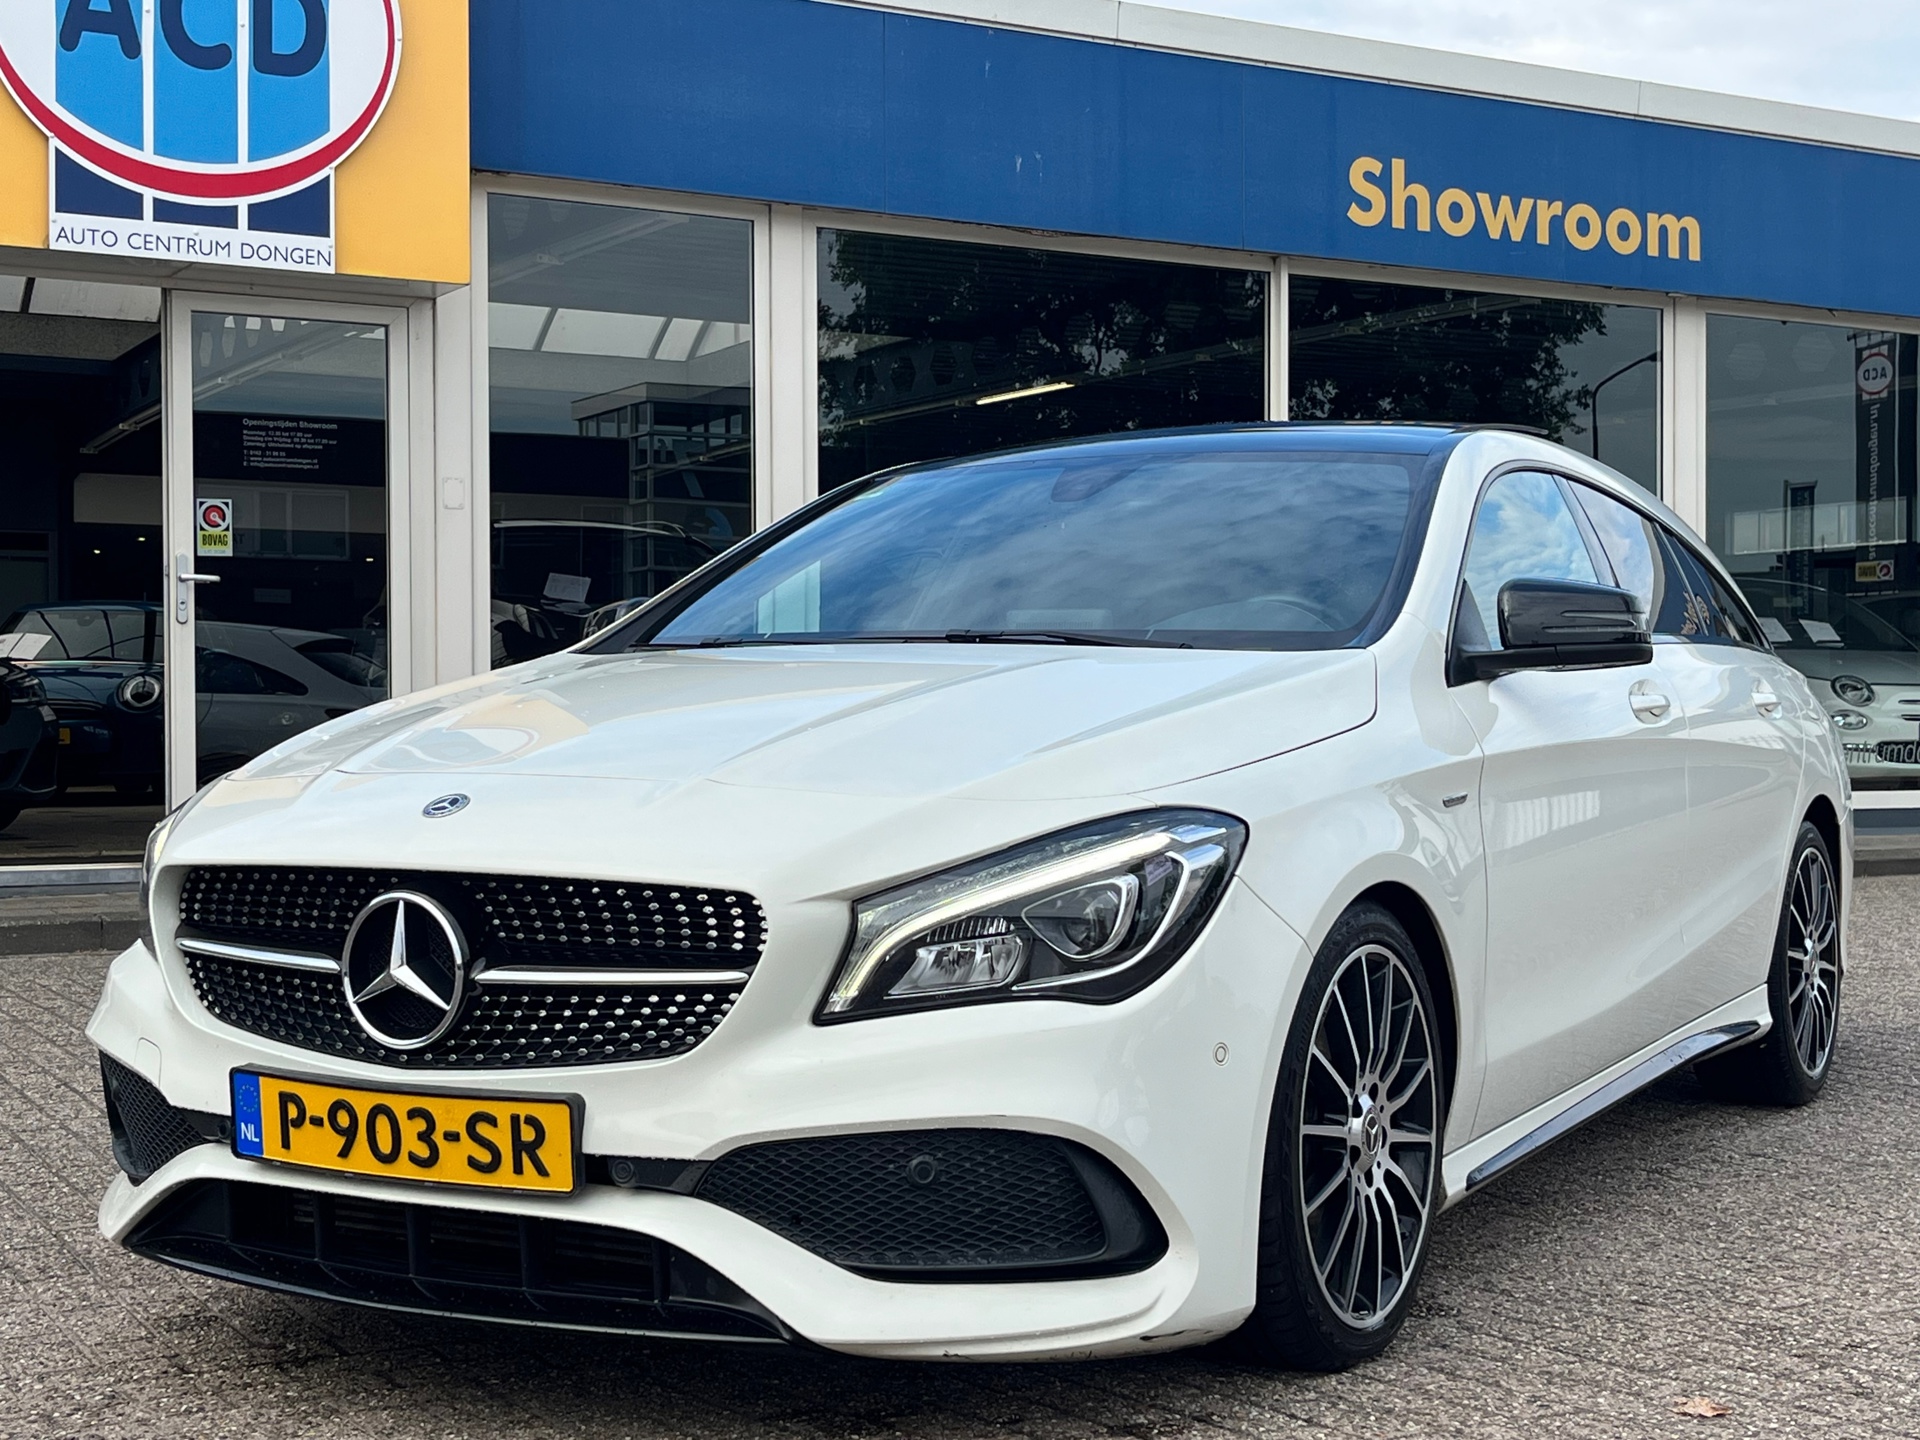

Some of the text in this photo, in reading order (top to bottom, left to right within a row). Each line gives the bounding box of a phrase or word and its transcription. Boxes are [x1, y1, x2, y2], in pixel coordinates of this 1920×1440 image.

[60, 0, 326, 77] ACD
[1347, 156, 1701, 261] Showroom
[55, 226, 332, 267] AUTO CENTRUM DONGEN
[243, 418, 338, 429] Openingstijden Showroom
[202, 534, 228, 546] BOVAG
[241, 1123, 259, 1143] NL
[278, 1091, 550, 1177] P-903-SR
